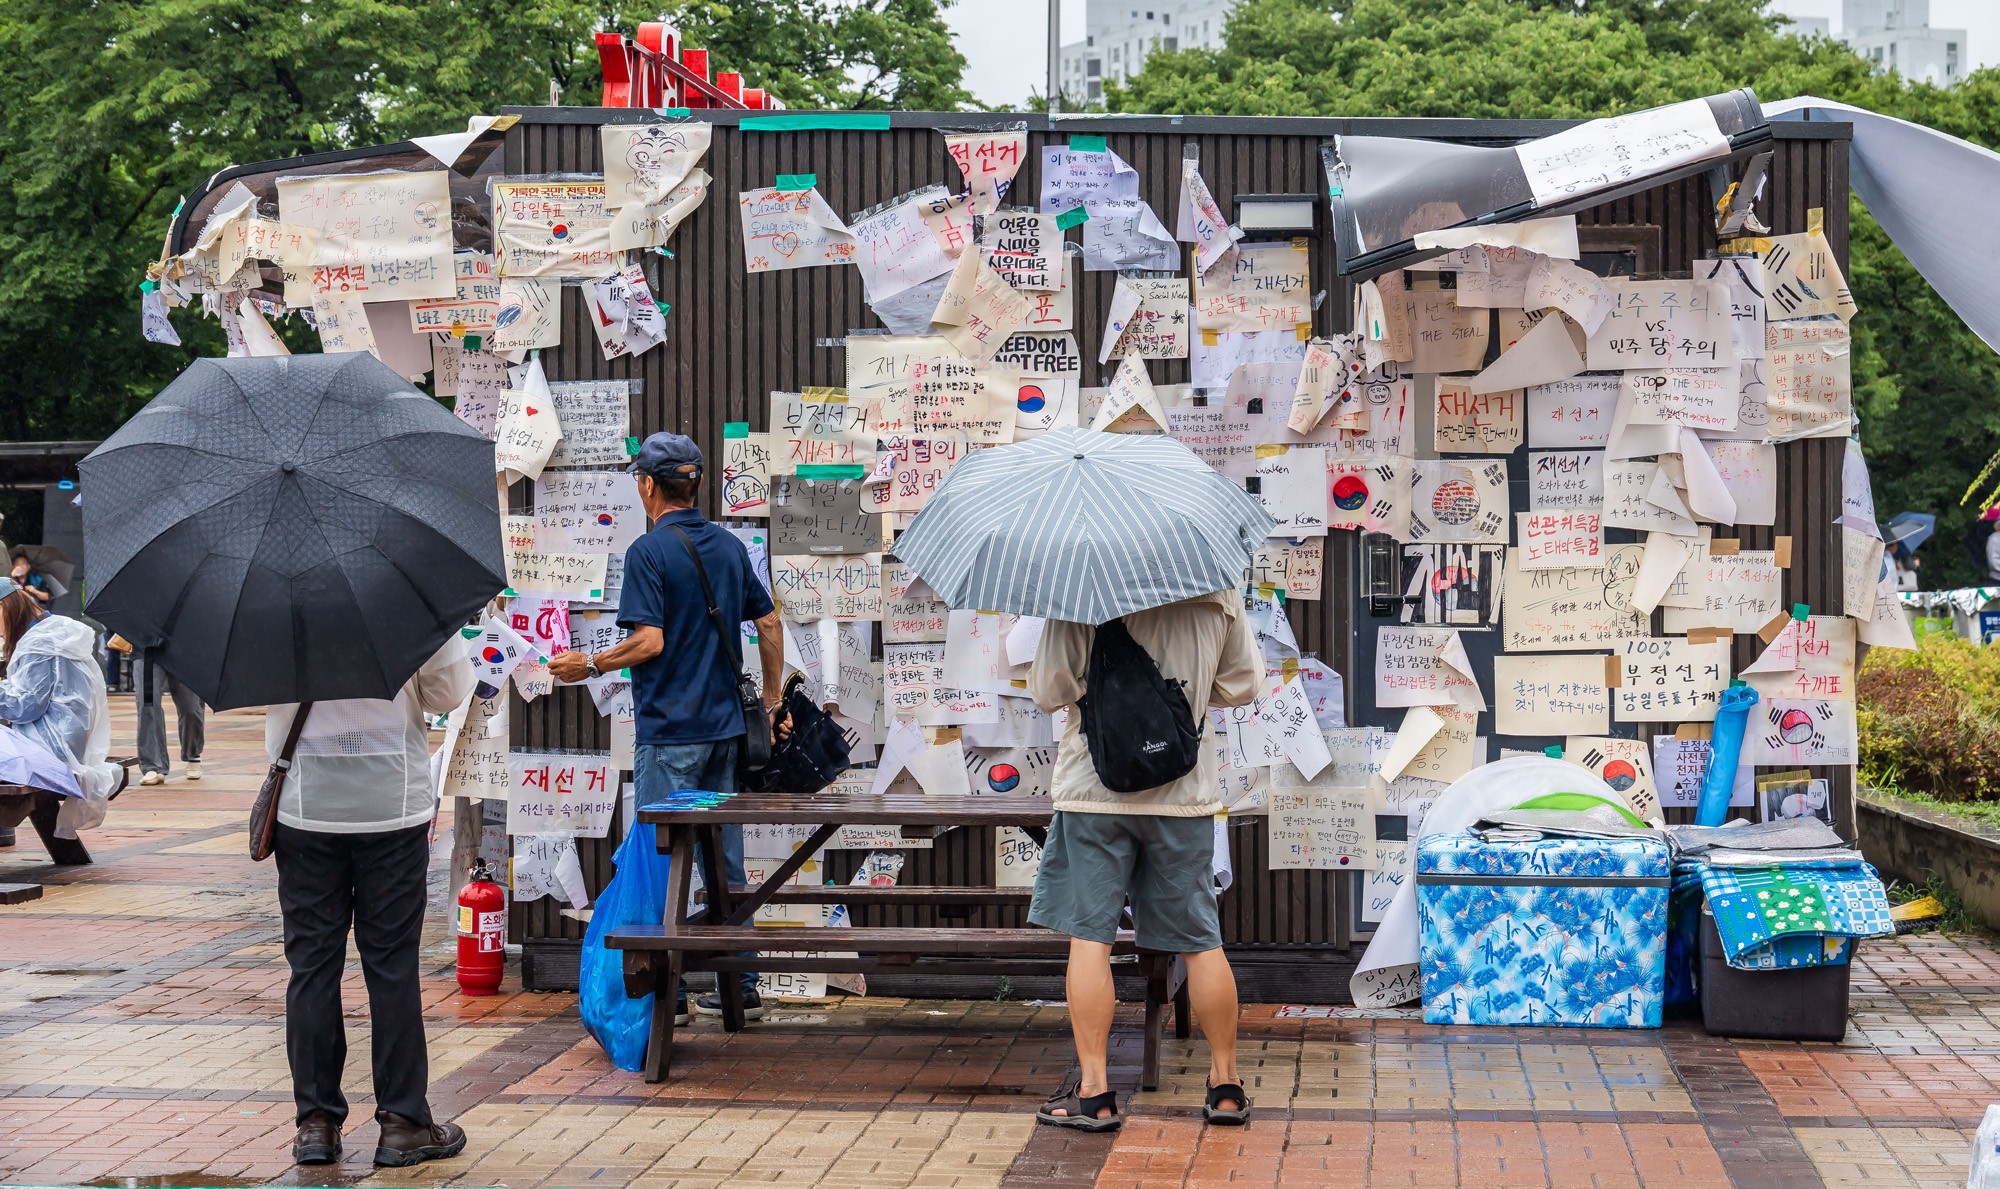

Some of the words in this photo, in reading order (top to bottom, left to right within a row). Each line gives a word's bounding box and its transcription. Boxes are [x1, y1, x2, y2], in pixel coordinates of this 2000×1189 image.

[1050, 153, 1061, 166] 이
[508, 186, 539, 197] 거룩한
[566, 186, 586, 197] 전투
[1050, 179, 1061, 189] 재
[749, 202, 792, 216] 이재명을
[1050, 197, 1060, 208] 명
[512, 202, 565, 220] 당일투표
[575, 203, 615, 217] 수개표
[998, 215, 1041, 239] 언론은
[237, 225, 302, 251] 부정선거
[996, 237, 1041, 258] 시민을
[572, 250, 613, 266] 재선거
[370, 256, 438, 287] 보장하라
[988, 256, 1049, 278] 시위대로
[1255, 274, 1305, 292] 재선거
[1148, 291, 1169, 300] Social
[1198, 292, 1251, 318] 당일투표
[1255, 305, 1303, 326] 수개표
[416, 310, 443, 325] 바로
[1420, 330, 1443, 342] THE
[1451, 326, 1486, 341] STEAL
[1768, 325, 1795, 347] 송파
[1802, 326, 1845, 341] 국회의원
[508, 338, 536, 347] 아니다
[995, 353, 1032, 371] NOT
[1033, 354, 1079, 373] FREE
[1556, 382, 1582, 393] 민주주의
[1633, 375, 1668, 392] STOP
[1672, 377, 1691, 389] THE
[1438, 390, 1514, 427] 재선거
[1681, 394, 1714, 407] 재선거
[782, 402, 869, 436] 부정선거
[1550, 406, 1599, 422] 재선거
[1775, 410, 1804, 424] 어디
[1182, 424, 1207, 433] 치시고는
[1228, 423, 1251, 432] 것이므로
[1482, 425, 1518, 442] 만세!!
[787, 439, 856, 465] 재선거
[1344, 438, 1378, 453] 마지막
[1536, 454, 1592, 479] 재선거!
[1537, 479, 1561, 492] 손자가
[507, 521, 529, 533] 한국은
[775, 565, 830, 591] 재선거
[830, 564, 880, 591] 재개표
[889, 569, 910, 583] 지난
[1737, 569, 1779, 584] 재선거!
[1525, 617, 1553, 636] Stop
[1559, 619, 1576, 631] the
[1585, 618, 1612, 632] Steal
[1381, 633, 1436, 650] 부정선거로
[1626, 640, 1673, 661] 100%
[887, 651, 937, 668] 부정선거를
[888, 672, 899, 687] 말
[901, 671, 926, 683] 못하는
[1383, 674, 1438, 691] 범죄집단을
[1794, 673, 1843, 695] 수개표
[524, 680, 549, 696] 재선거
[1512, 679, 1550, 697] 불의에
[1556, 682, 1602, 697] 저항하는
[893, 690, 927, 706] 국민들이
[1514, 699, 1536, 713] 것이
[1142, 741, 1169, 752] KANGOL
[521, 765, 606, 794] 재선거
[518, 803, 556, 818] 자신을
[1315, 797, 1337, 810] 의무는
[841, 827, 875, 838] 부정선거
[1317, 831, 1332, 842] 전면
